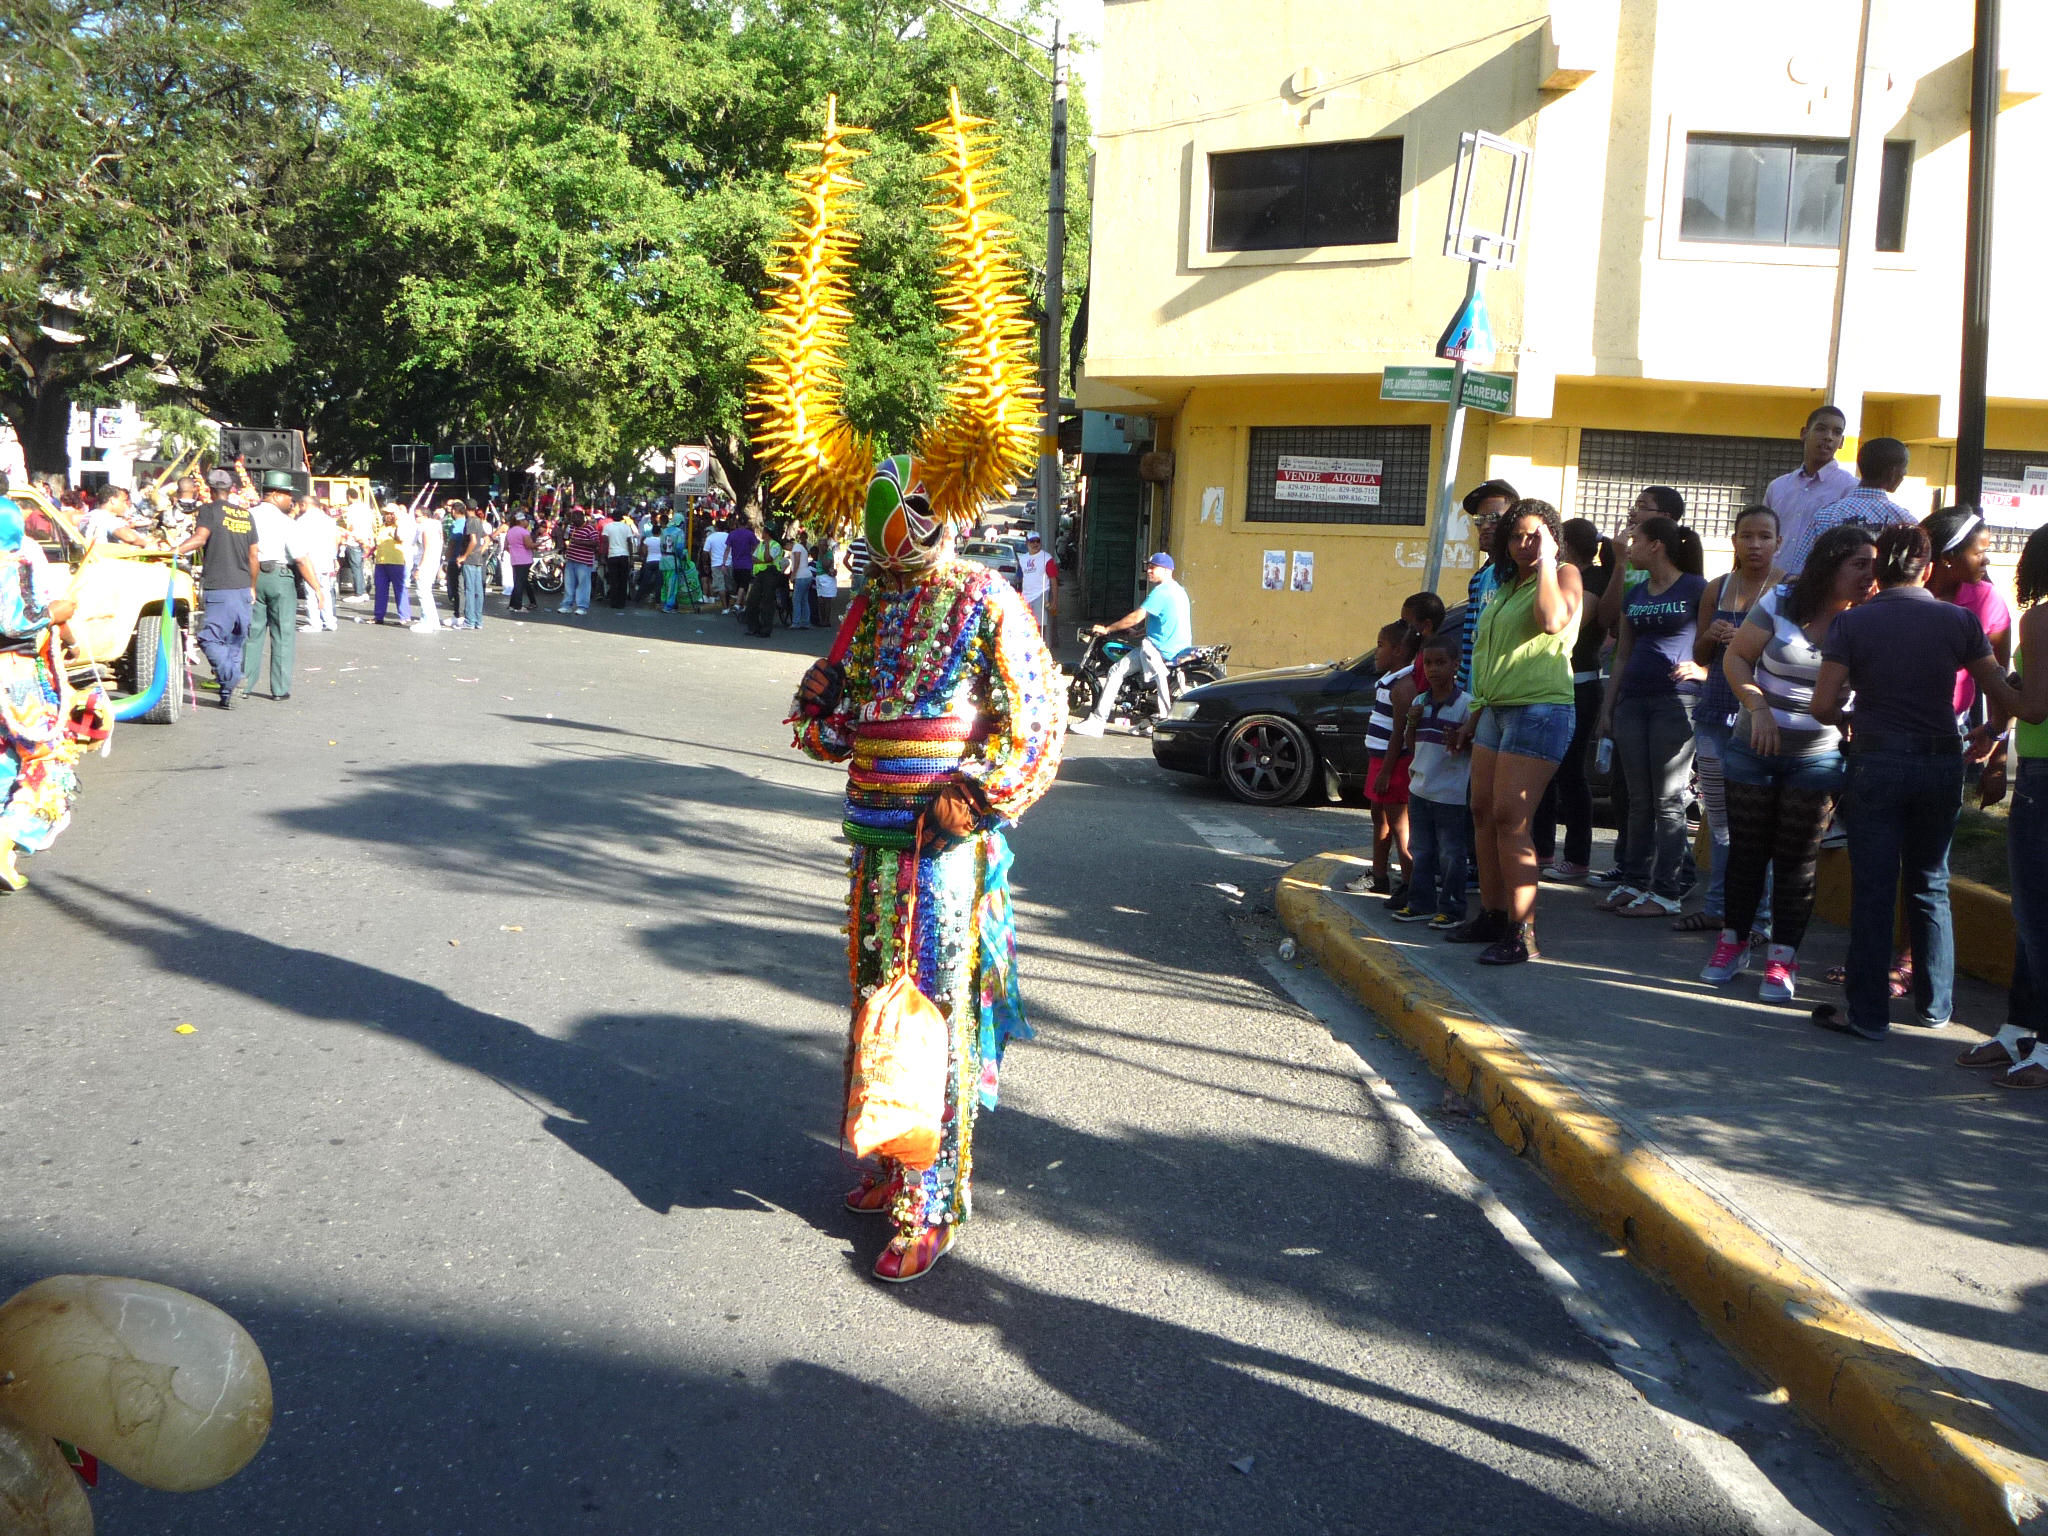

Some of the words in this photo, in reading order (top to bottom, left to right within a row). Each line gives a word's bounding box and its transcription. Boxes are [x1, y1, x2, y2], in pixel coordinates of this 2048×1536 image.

[1408, 369, 1428, 377] Avenida
[1467, 373, 1486, 383] Avenida
[1463, 383, 1509, 403] CARRERAS
[1284, 471, 1321, 482] VENDE
[1332, 473, 1376, 484] ALQUILA
[1626, 601, 1687, 616] ROPOSTALE
